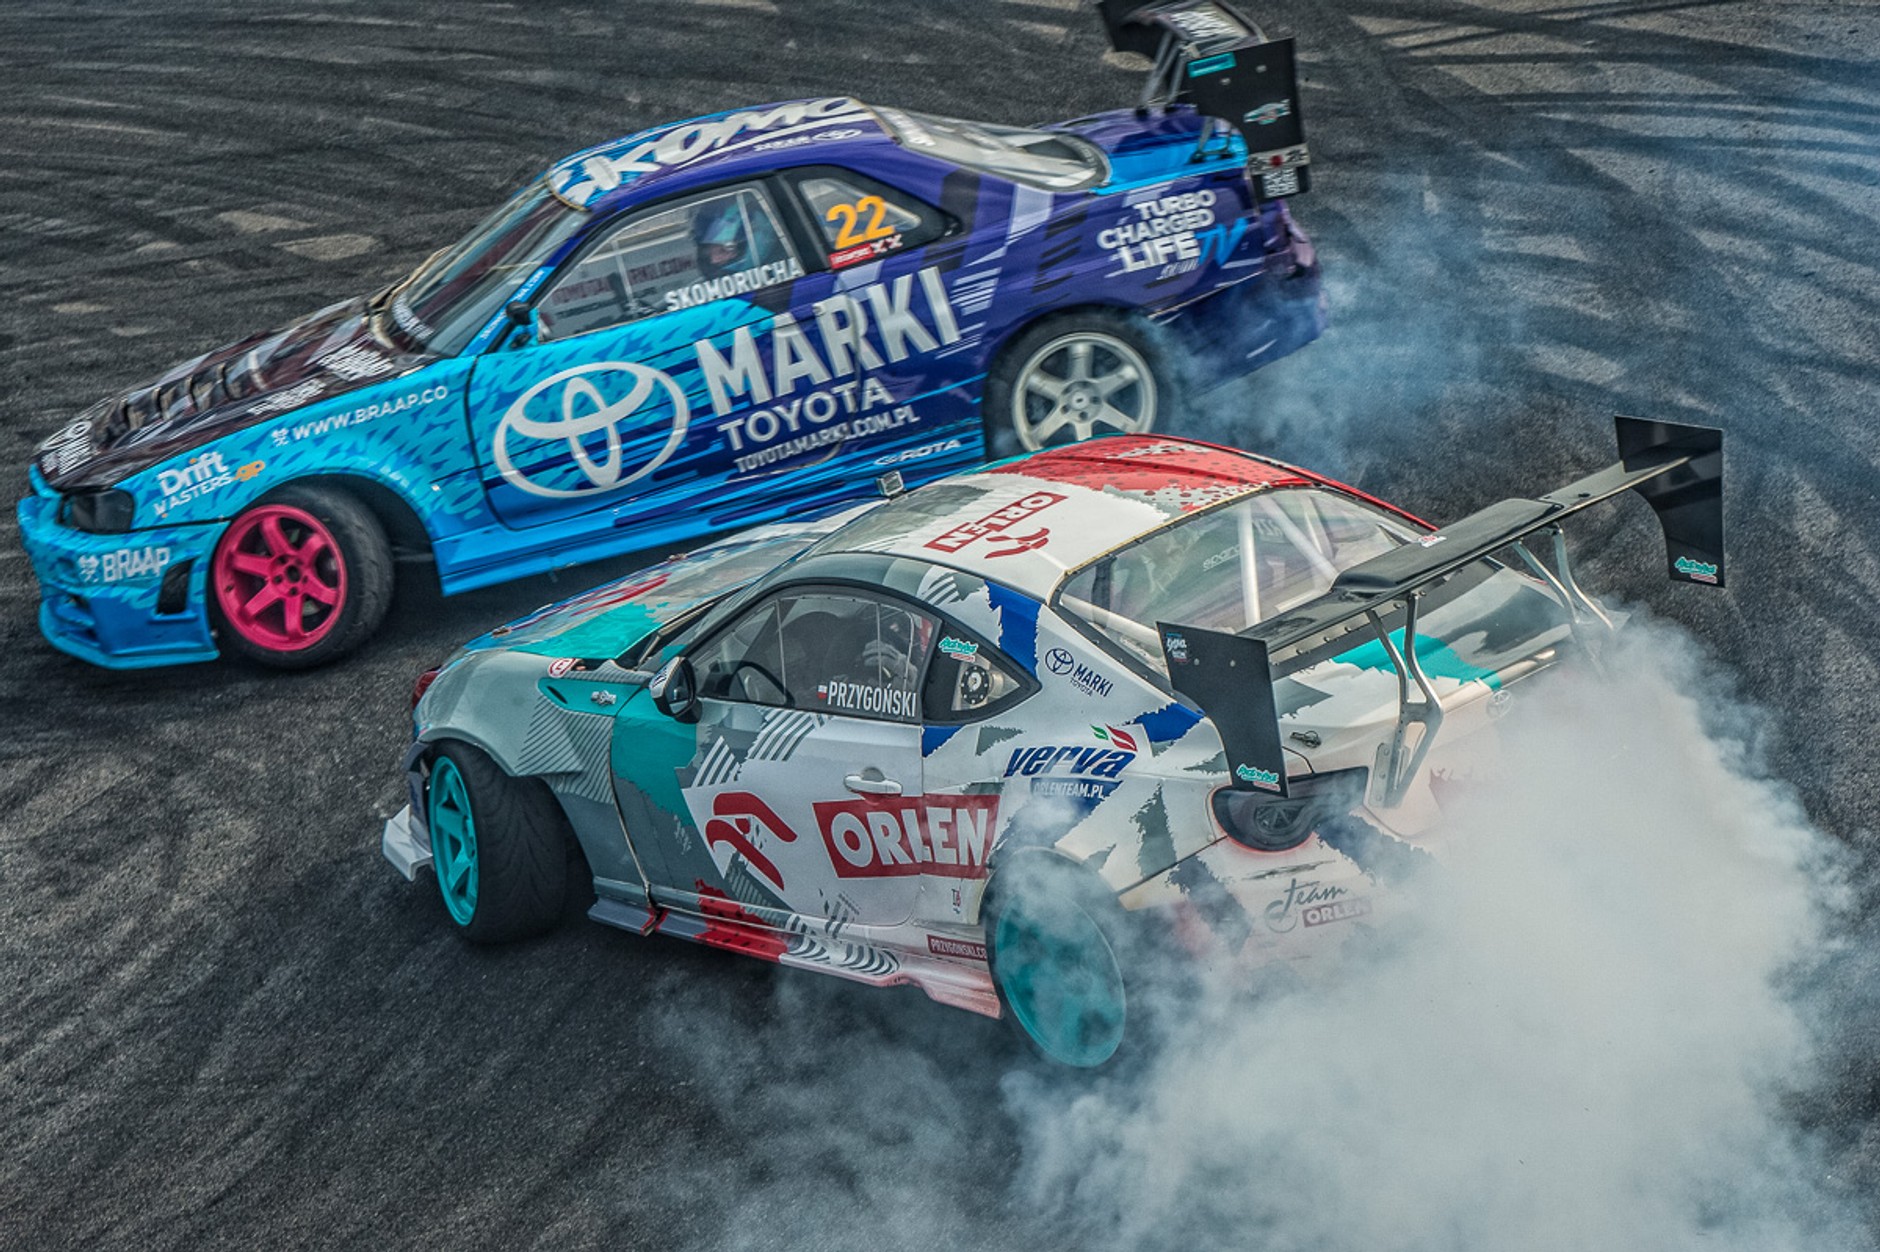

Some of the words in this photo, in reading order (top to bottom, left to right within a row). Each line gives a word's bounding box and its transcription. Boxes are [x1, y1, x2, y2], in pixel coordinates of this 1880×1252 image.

[826, 195, 895, 250] 22
[1097, 208, 1216, 249] CHARGED
[1133, 189, 1217, 220] TURBO
[1117, 231, 1201, 273] LIFE
[1195, 217, 1249, 268] TV
[664, 256, 806, 312] SKOMORUCHA
[694, 265, 962, 418] MARKI
[292, 385, 449, 441] WWW.BRAAP.CO
[717, 376, 896, 451] TOYOTA
[734, 404, 921, 474] TOYOTAMARKI.COM.PL
[157, 451, 229, 497] Drift
[934, 494, 1054, 549] ORLEN
[102, 547, 170, 583] BRAAP
[827, 680, 917, 718] PRZYGOŃSKI
[1073, 662, 1114, 697] MARKI
[1003, 746, 1136, 779] verva
[1034, 780, 1106, 798] ORLENTEAM.PL
[831, 807, 989, 868] ORLEN
